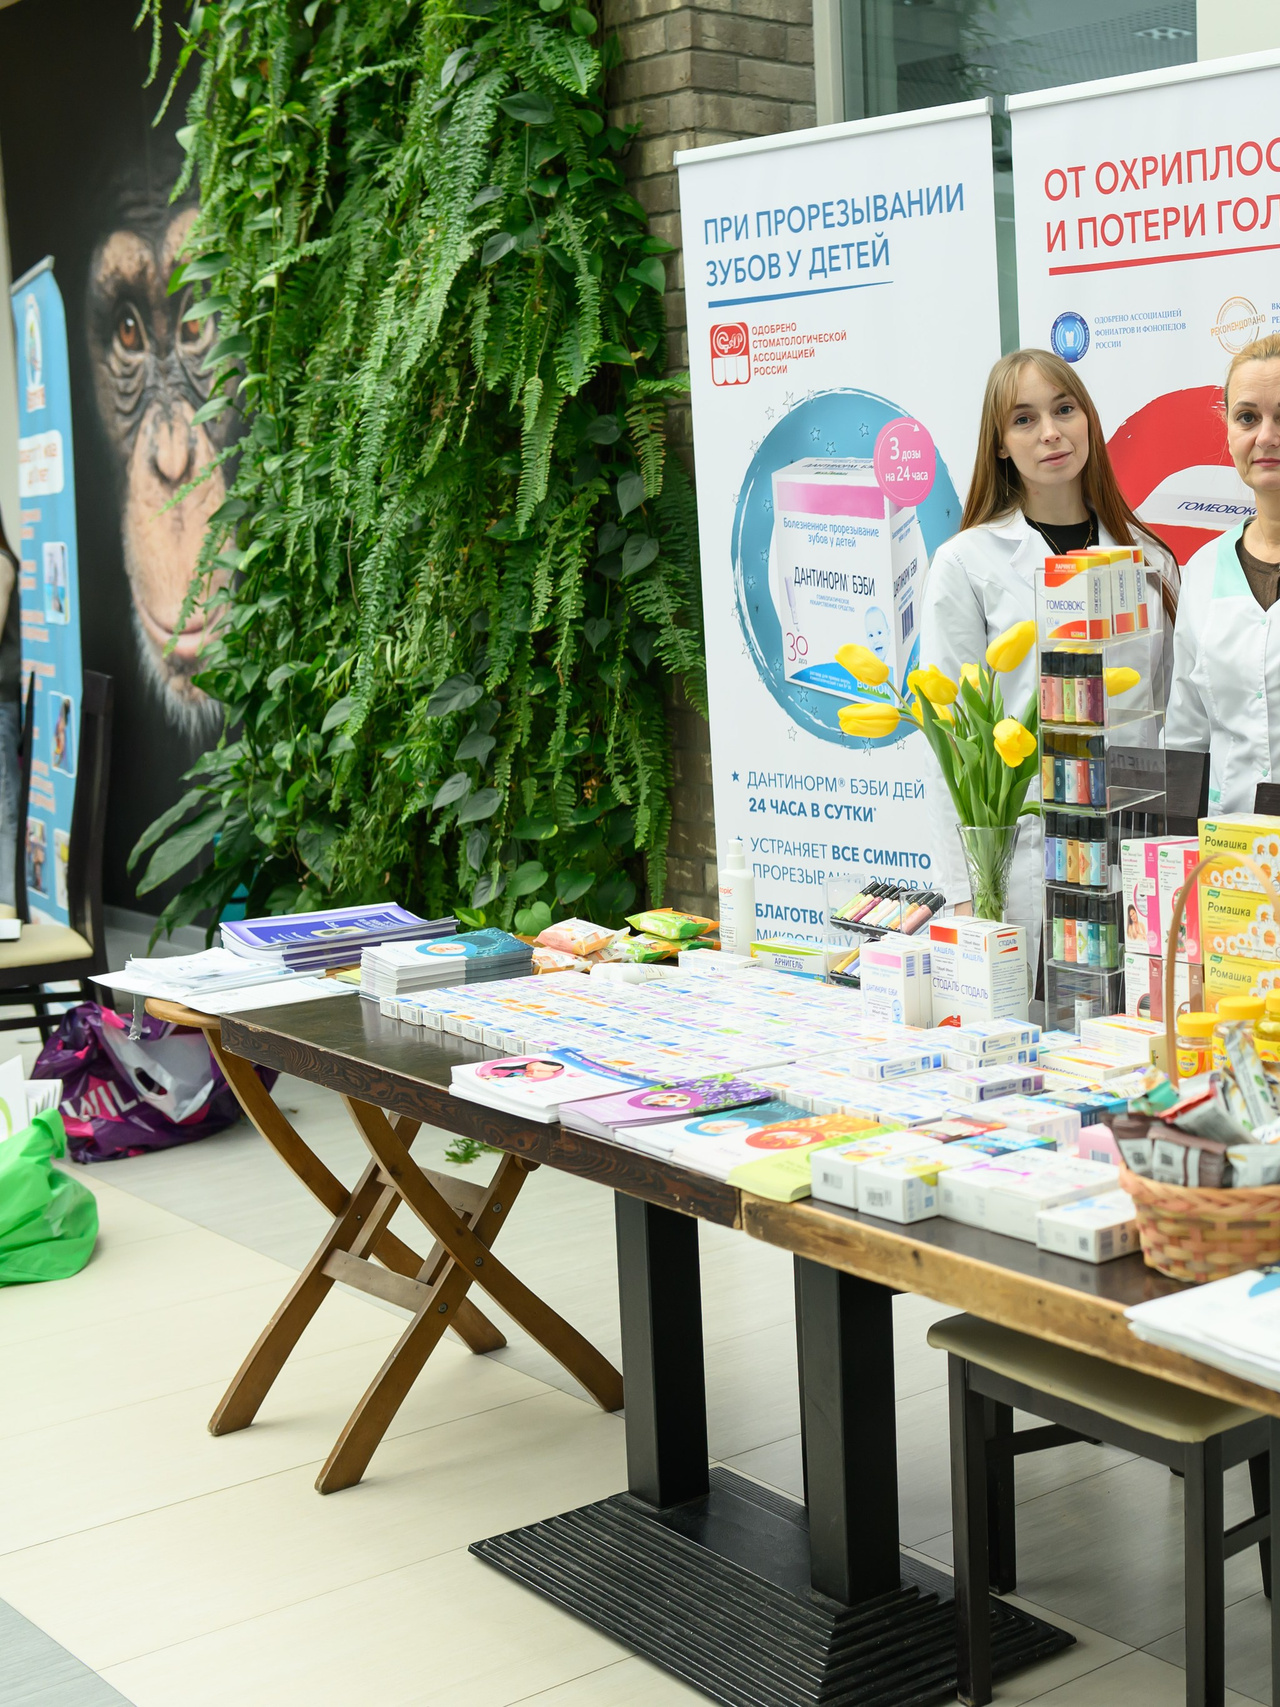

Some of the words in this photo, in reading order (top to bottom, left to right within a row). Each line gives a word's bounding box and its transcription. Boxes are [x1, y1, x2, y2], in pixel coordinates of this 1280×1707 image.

[1044, 166, 1086, 201] ОТ
[704, 214, 749, 245] ПРИ
[756, 183, 965, 238] ПРОРЕЗЫВАНИИ
[1047, 220, 1066, 253] И
[1078, 204, 1206, 249] ПОТЕРИ
[706, 253, 781, 287] ЗУБОВ
[787, 249, 802, 277] У
[809, 232, 890, 280] ДЕТЕЙ
[1094, 314, 1128, 324] ОДОБРЕНО
[1129, 308, 1182, 322] АССОЦИАЦИЕЙ
[752, 322, 797, 336] ОДОБРЕНО
[1094, 326, 1135, 338] ФОНИАТРОВ
[1142, 322, 1186, 334] ФОНОПЕДОВ
[1210, 313, 1266, 337] РЕКОМЕНДОВАНО
[752, 331, 847, 349] СТОМАТОЛОГИЧЕСКОЙ
[1095, 340, 1121, 350] РОССИИ
[753, 347, 815, 363] АССОЦИАЦИЕЙ
[754, 365, 788, 376] РОССИИ
[889, 437, 899, 460] 3
[901, 450, 921, 462] дозы
[885, 473, 895, 482] на
[896, 466, 910, 482] 24
[911, 471, 928, 482] часа
[783, 517, 827, 532] Болезненное
[829, 525, 880, 537] прорезывание
[808, 533, 828, 545] зубов
[836, 537, 857, 547] детей
[852, 575, 876, 596] БЭБИ
[1046, 600, 1086, 611] ГОМЕОВОКС
[785, 632, 809, 662] 30
[850, 779, 889, 797] БЭБИ
[892, 780, 927, 801] ДЕЙ
[749, 798, 766, 813] 24
[770, 799, 807, 817] ЧАСА
[812, 803, 820, 818] В
[750, 837, 828, 860] УСТРАНЯЕТ
[832, 845, 860, 863] ВСЕ
[1205, 836, 1247, 850] Ромашка
[1207, 902, 1250, 917] Ромашка
[998, 938, 1017, 947] СТОДАЛЬ
[934, 946, 955, 956] КАШЕЛЬ
[962, 952, 984, 963] КАШЕЛЬ
[774, 957, 803, 970] АРНИГЕЛЬ
[1210, 967, 1252, 983] Ромашка
[932, 978, 960, 992] СТОДАЛЬ
[961, 984, 988, 1000] СТОДАЛЬ
